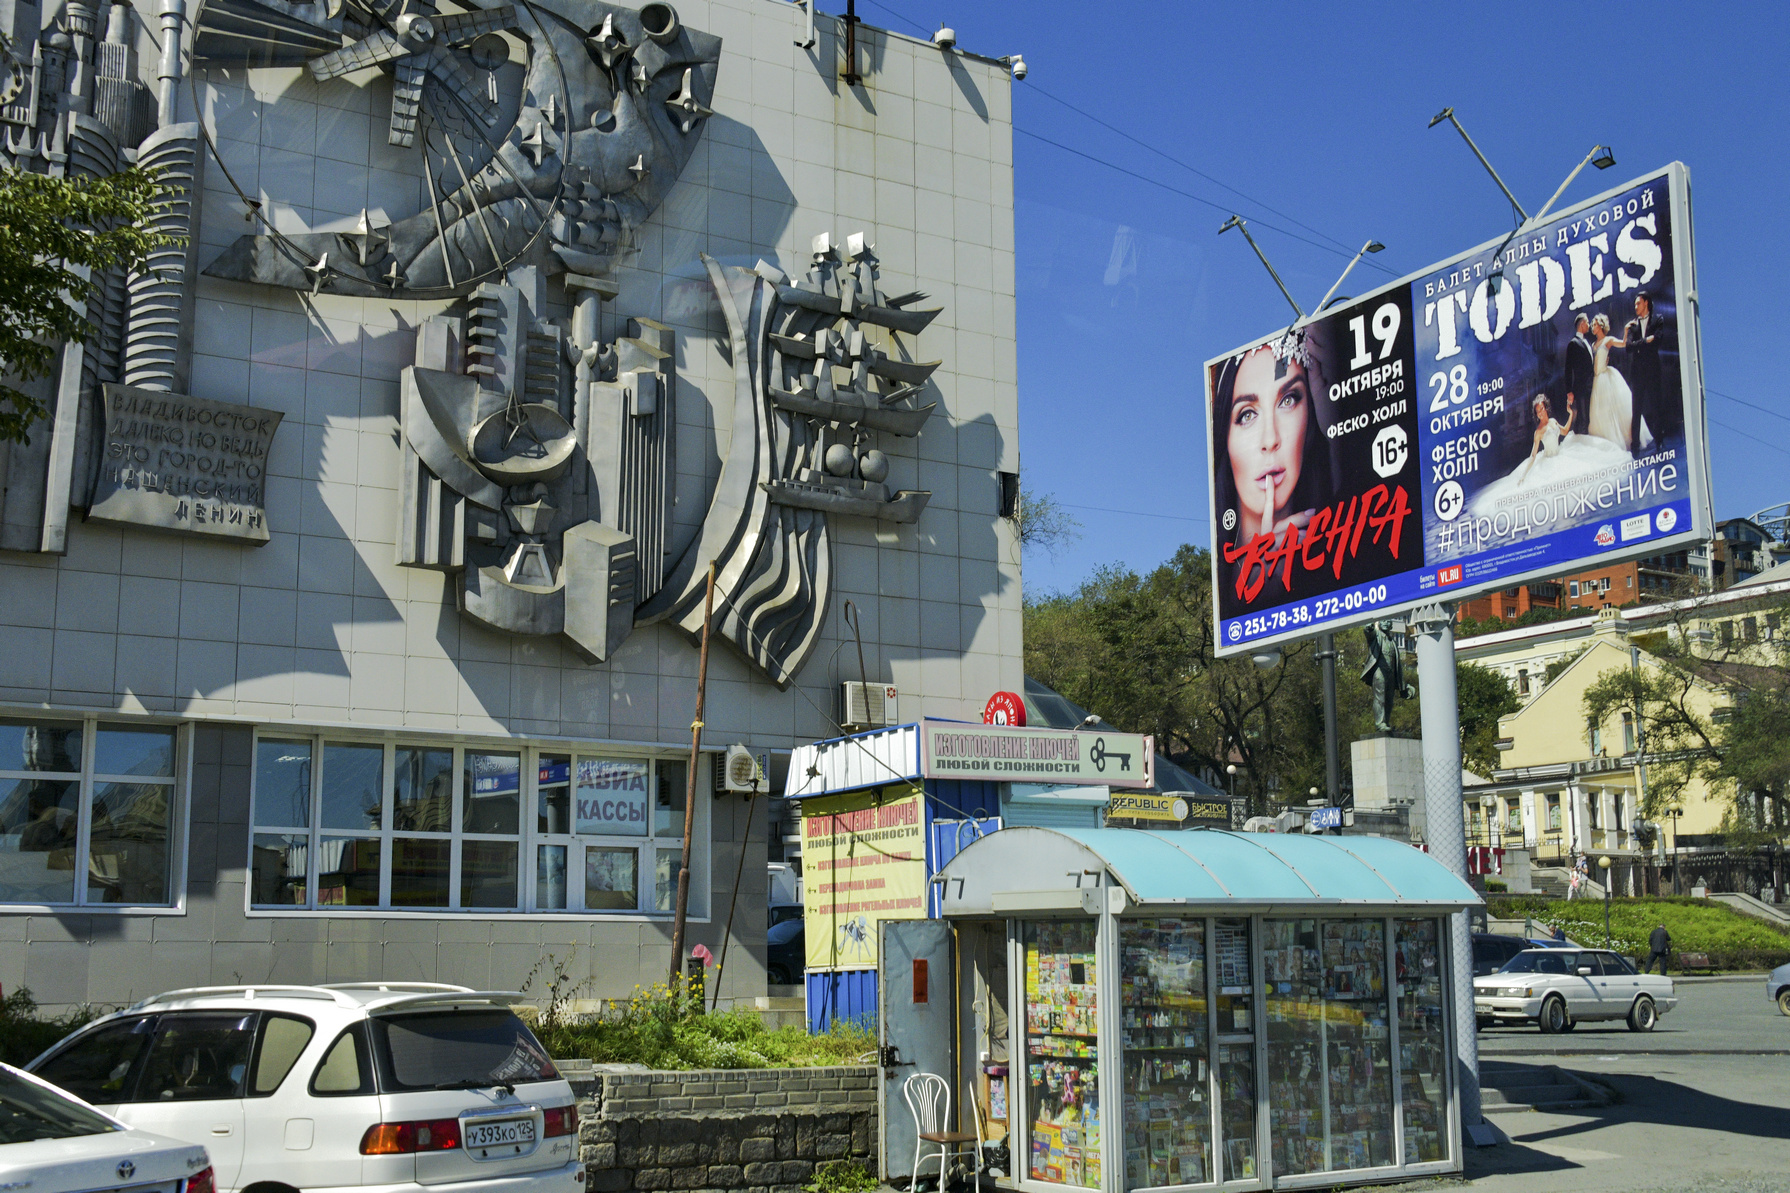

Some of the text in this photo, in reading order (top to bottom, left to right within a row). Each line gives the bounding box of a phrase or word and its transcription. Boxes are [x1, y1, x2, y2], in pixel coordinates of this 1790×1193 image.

[1425, 188, 1655, 298] БАЛЕТ АЛЛЫ ДУХОВОЙ
[1424, 212, 1662, 361] TODES
[1349, 302, 1401, 371] 19
[1329, 359, 1403, 401] ОКТЯБРЯ
[1375, 379, 1404, 400] 19:00
[1428, 363, 1469, 413] 28
[1476, 376, 1504, 396] 19:00
[112, 393, 271, 435] ВЛАДИВОСТОК
[1326, 399, 1407, 439] ФЕСКО ХОЛЛ
[1430, 395, 1504, 435] ОКТЯБРЯ
[107, 442, 261, 480] ЭТО ГОРОД-ТО
[1377, 436, 1407, 468] 16+
[1431, 429, 1492, 463] ФЕСКО
[105, 466, 260, 501] НАШЕНСКИЙ
[1432, 452, 1478, 484] ХОЛЛ
[1495, 449, 1676, 508] ПРЕМЬЕРА ТАНЦЕВАЛЬНОГО СПЕКТАКЛЯ
[175, 500, 261, 528] ЛЕНИН
[1437, 463, 1678, 554] #продолжение
[1438, 488, 1461, 514] 6+
[1223, 484, 1412, 604] ВАЕНГА
[1440, 568, 1459, 583] VL.RU
[1244, 584, 1387, 637] 251-78-38, 272-00-00
[935, 733, 1080, 761] ИЗГОТОВЛЕНИЕ КЛЮЧЕЙ
[577, 771, 645, 792] АВИА
[936, 758, 1080, 773] ЛЮБОЙ СЛОЖНОСТИ
[577, 799, 645, 822] КАССЫ
[807, 798, 919, 838] ИЗГОТОВЛЕНИЕ КЛЮЧЕЙ
[1112, 797, 1169, 810] REPUBLIC
[1192, 802, 1227, 813] БЫСТРОЕ
[807, 827, 919, 850] ЛЮБОЙ СЛОЖНОСТИ
[818, 856, 859, 871] ИЗГОТОВЛЕНИЕ
[819, 901, 860, 915] ИЗГОТОВЛЕНИЕ
[471, 1122, 531, 1144] У393КО 125
